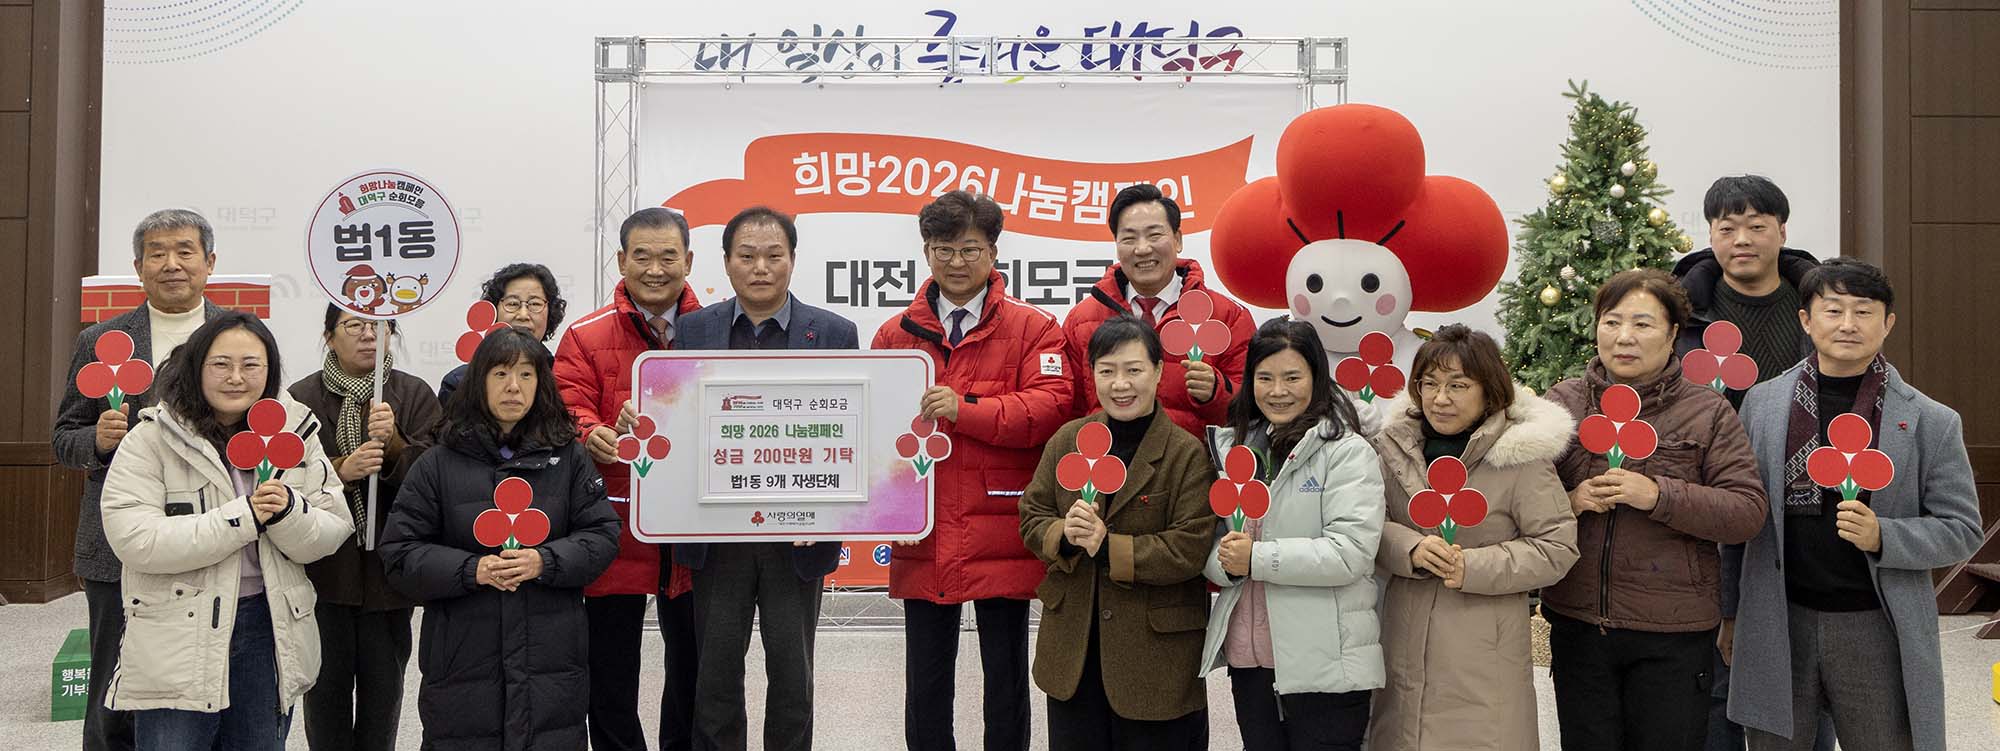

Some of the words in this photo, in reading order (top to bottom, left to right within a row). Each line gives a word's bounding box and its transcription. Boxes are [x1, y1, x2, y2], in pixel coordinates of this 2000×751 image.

[334, 221, 436, 262] 법1동
[825, 259, 916, 307] 대전
[773, 398, 803, 410] 대덕구
[809, 398, 848, 411] 순회모금
[720, 424, 745, 439] 희망
[749, 424, 779, 438] 2026
[785, 423, 844, 439] 나눔캠페인
[713, 448, 744, 465] 성금
[753, 447, 813, 464] 200만원
[823, 447, 854, 464] 기탁
[731, 474, 761, 489] 법1동
[766, 474, 786, 489] 9개
[792, 473, 840, 489] 자생단체
[61, 684, 89, 696] 기부
